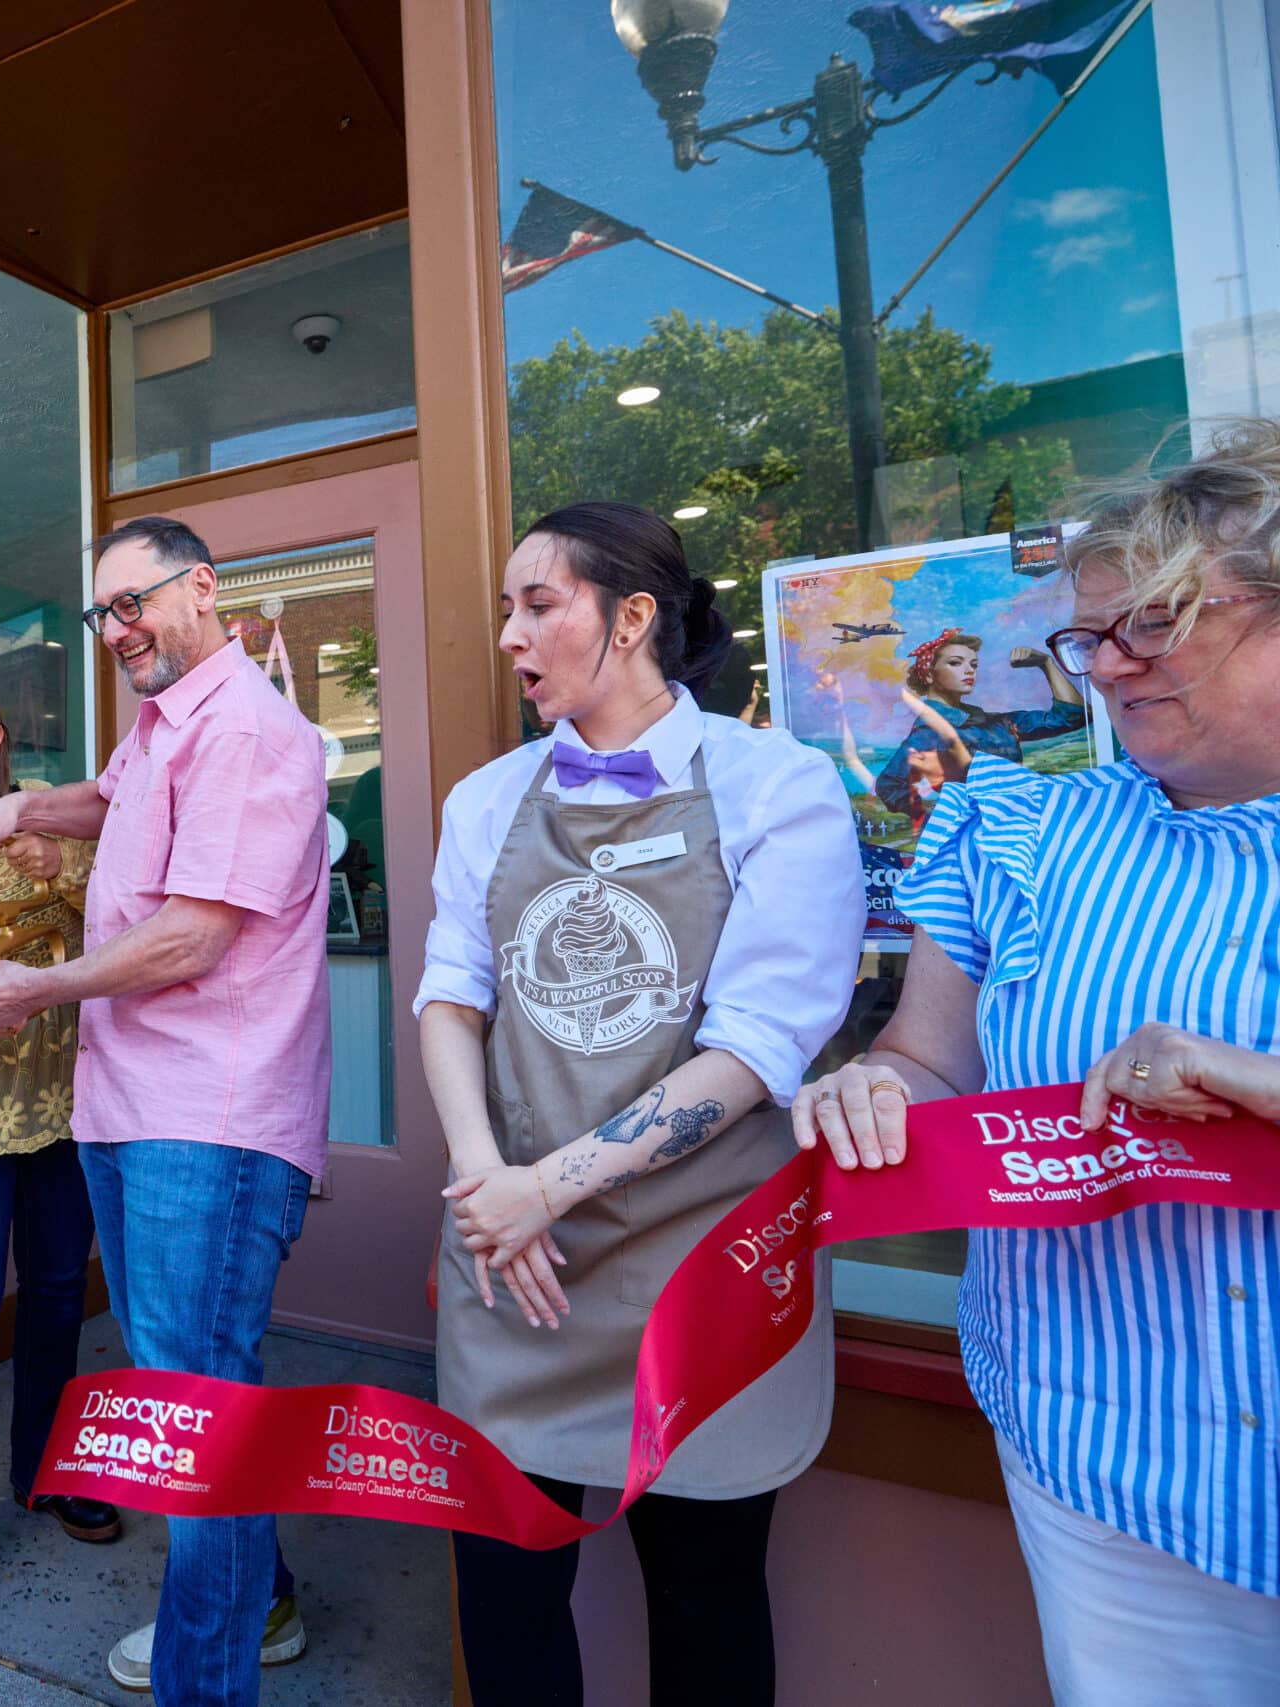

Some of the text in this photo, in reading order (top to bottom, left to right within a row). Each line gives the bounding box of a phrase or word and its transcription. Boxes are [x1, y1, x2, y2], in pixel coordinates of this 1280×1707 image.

[1016, 536, 1057, 549] America
[1019, 544, 1056, 563] 250
[527, 896, 653, 938] SENECA FALLS
[523, 971, 665, 1006] IT'S A WONDERFUL SCOOP
[545, 1011, 641, 1039] NEW YORK
[1001, 1137, 1195, 1185] Seneca
[988, 1163, 1232, 1204] Seneca County Chamber of Commerce
[80, 1389, 213, 1440] Discover
[324, 1405, 467, 1459] Discover
[74, 1426, 196, 1475] Seneca
[326, 1443, 448, 1489] Seneca
[55, 1458, 211, 1493] Seneca County Chamber of Commerce
[307, 1476, 465, 1508] Seneca County Chamber of Commerce
